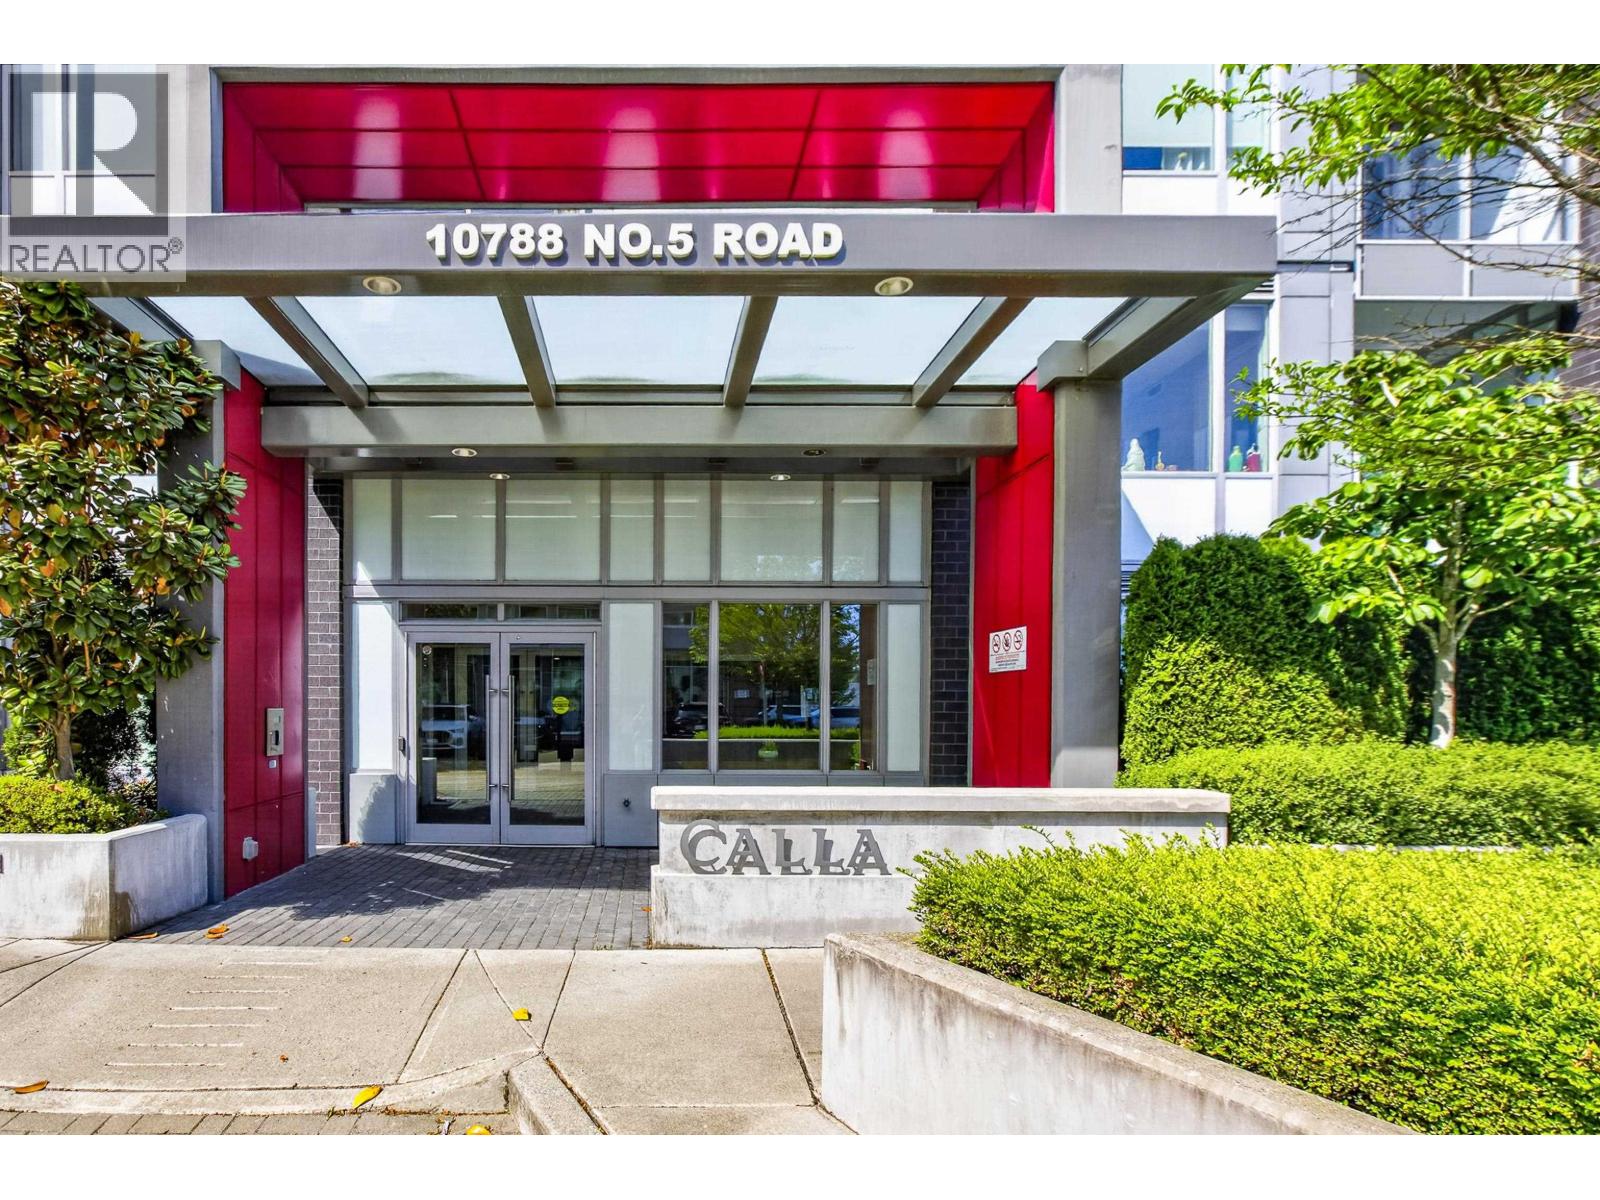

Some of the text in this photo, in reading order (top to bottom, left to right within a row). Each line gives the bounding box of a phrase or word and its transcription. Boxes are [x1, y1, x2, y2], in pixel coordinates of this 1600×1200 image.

[425, 222, 844, 260] 10788 NO.5 ROAD
[680, 819, 892, 876] CALLA
